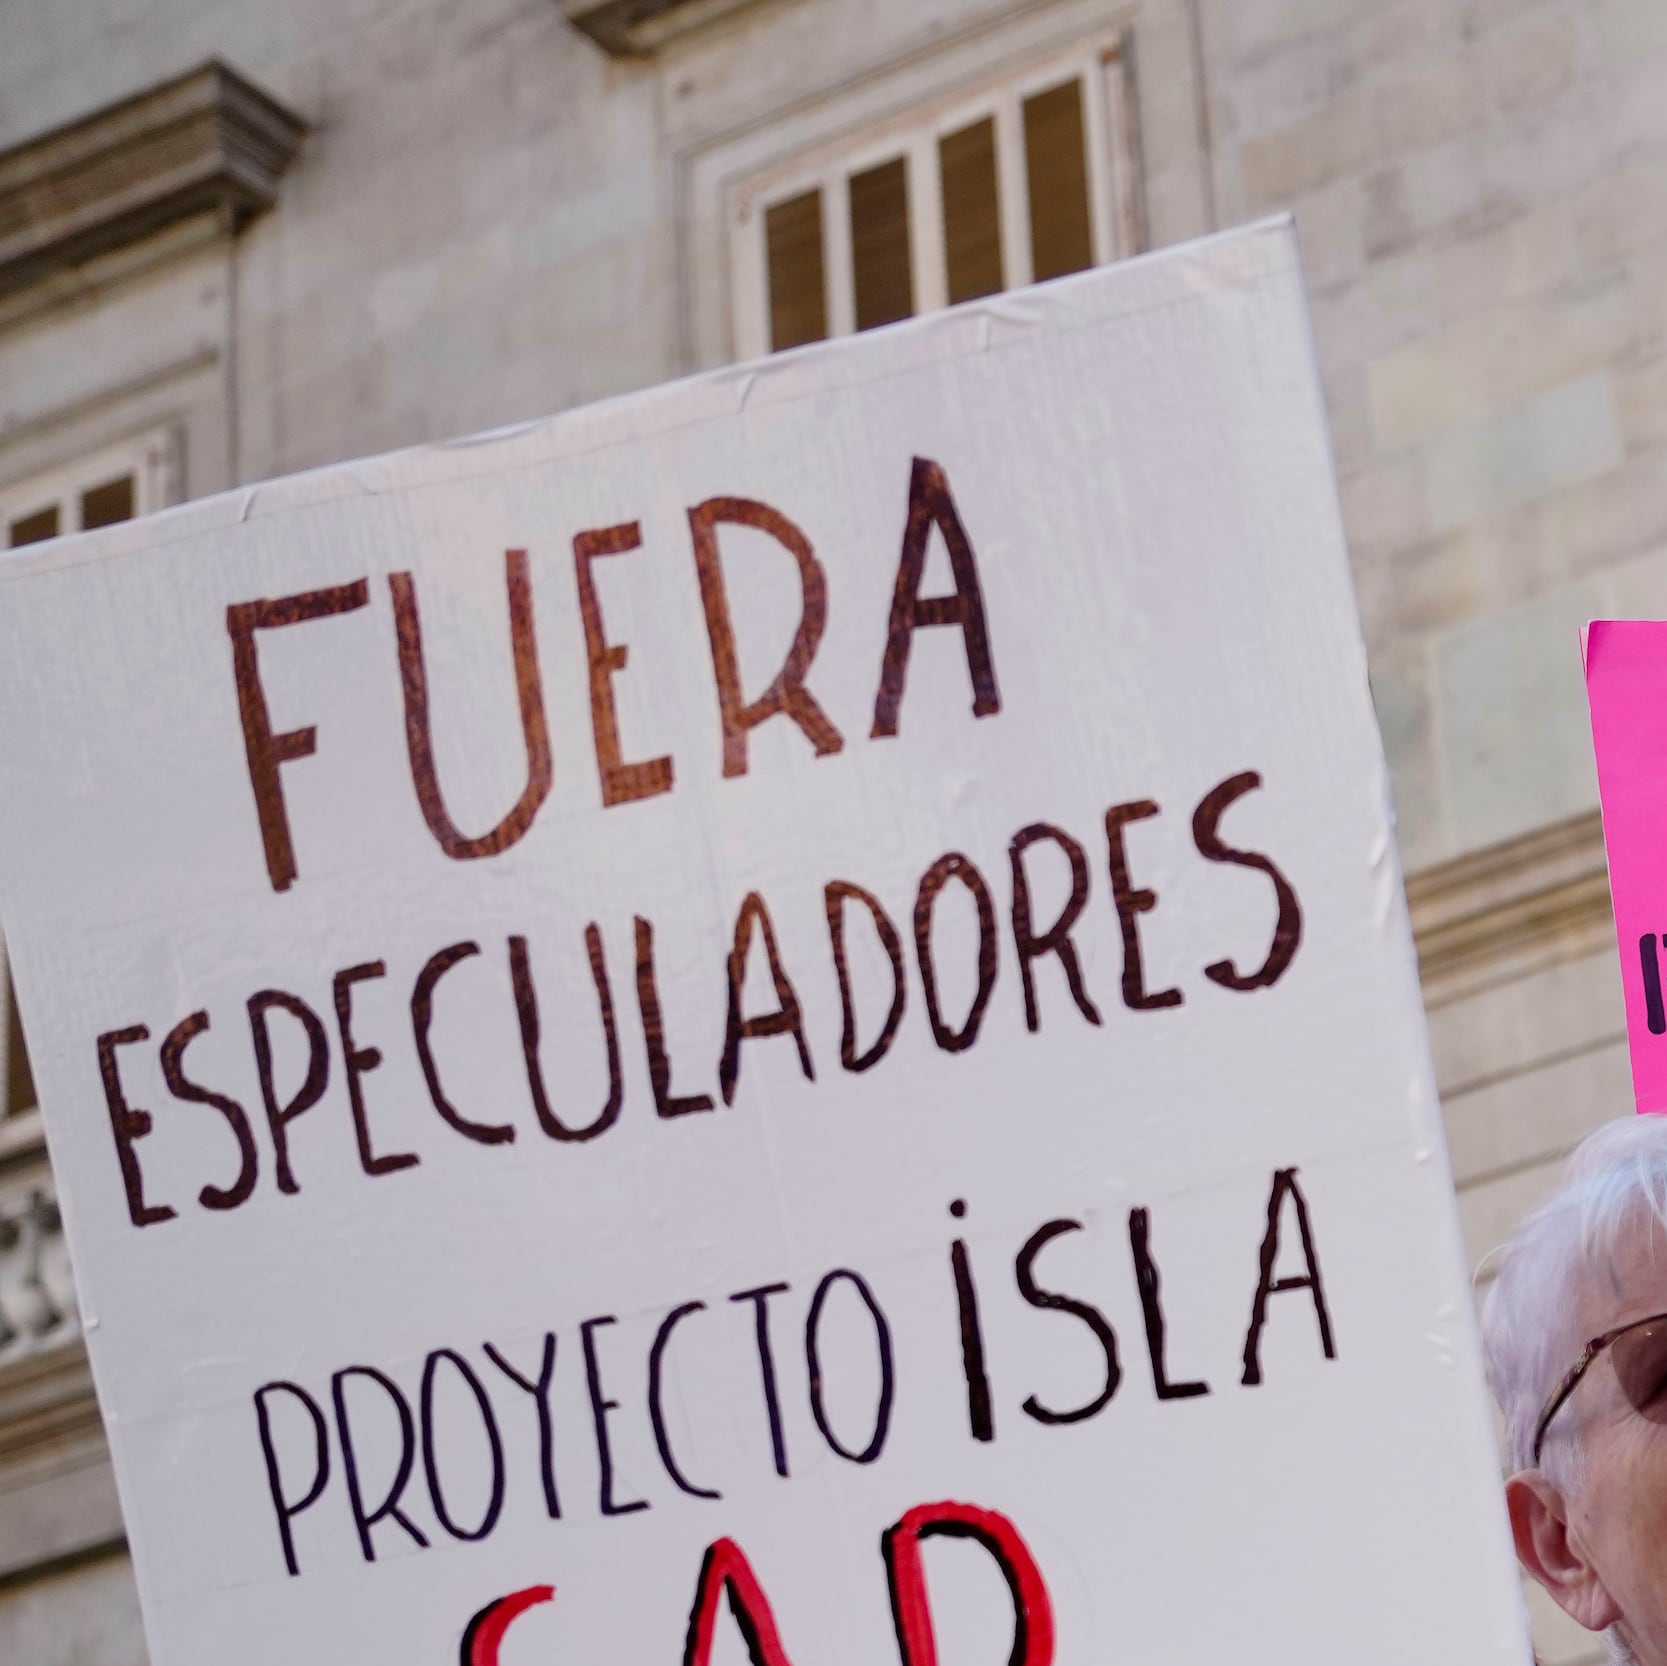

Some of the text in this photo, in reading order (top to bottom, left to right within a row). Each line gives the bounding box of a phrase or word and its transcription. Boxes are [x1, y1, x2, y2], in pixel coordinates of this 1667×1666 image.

[225, 455, 1003, 892] FUERA
[97, 770, 1304, 1230] ESPECULADORES
[253, 1267, 898, 1579] PROYECTO
